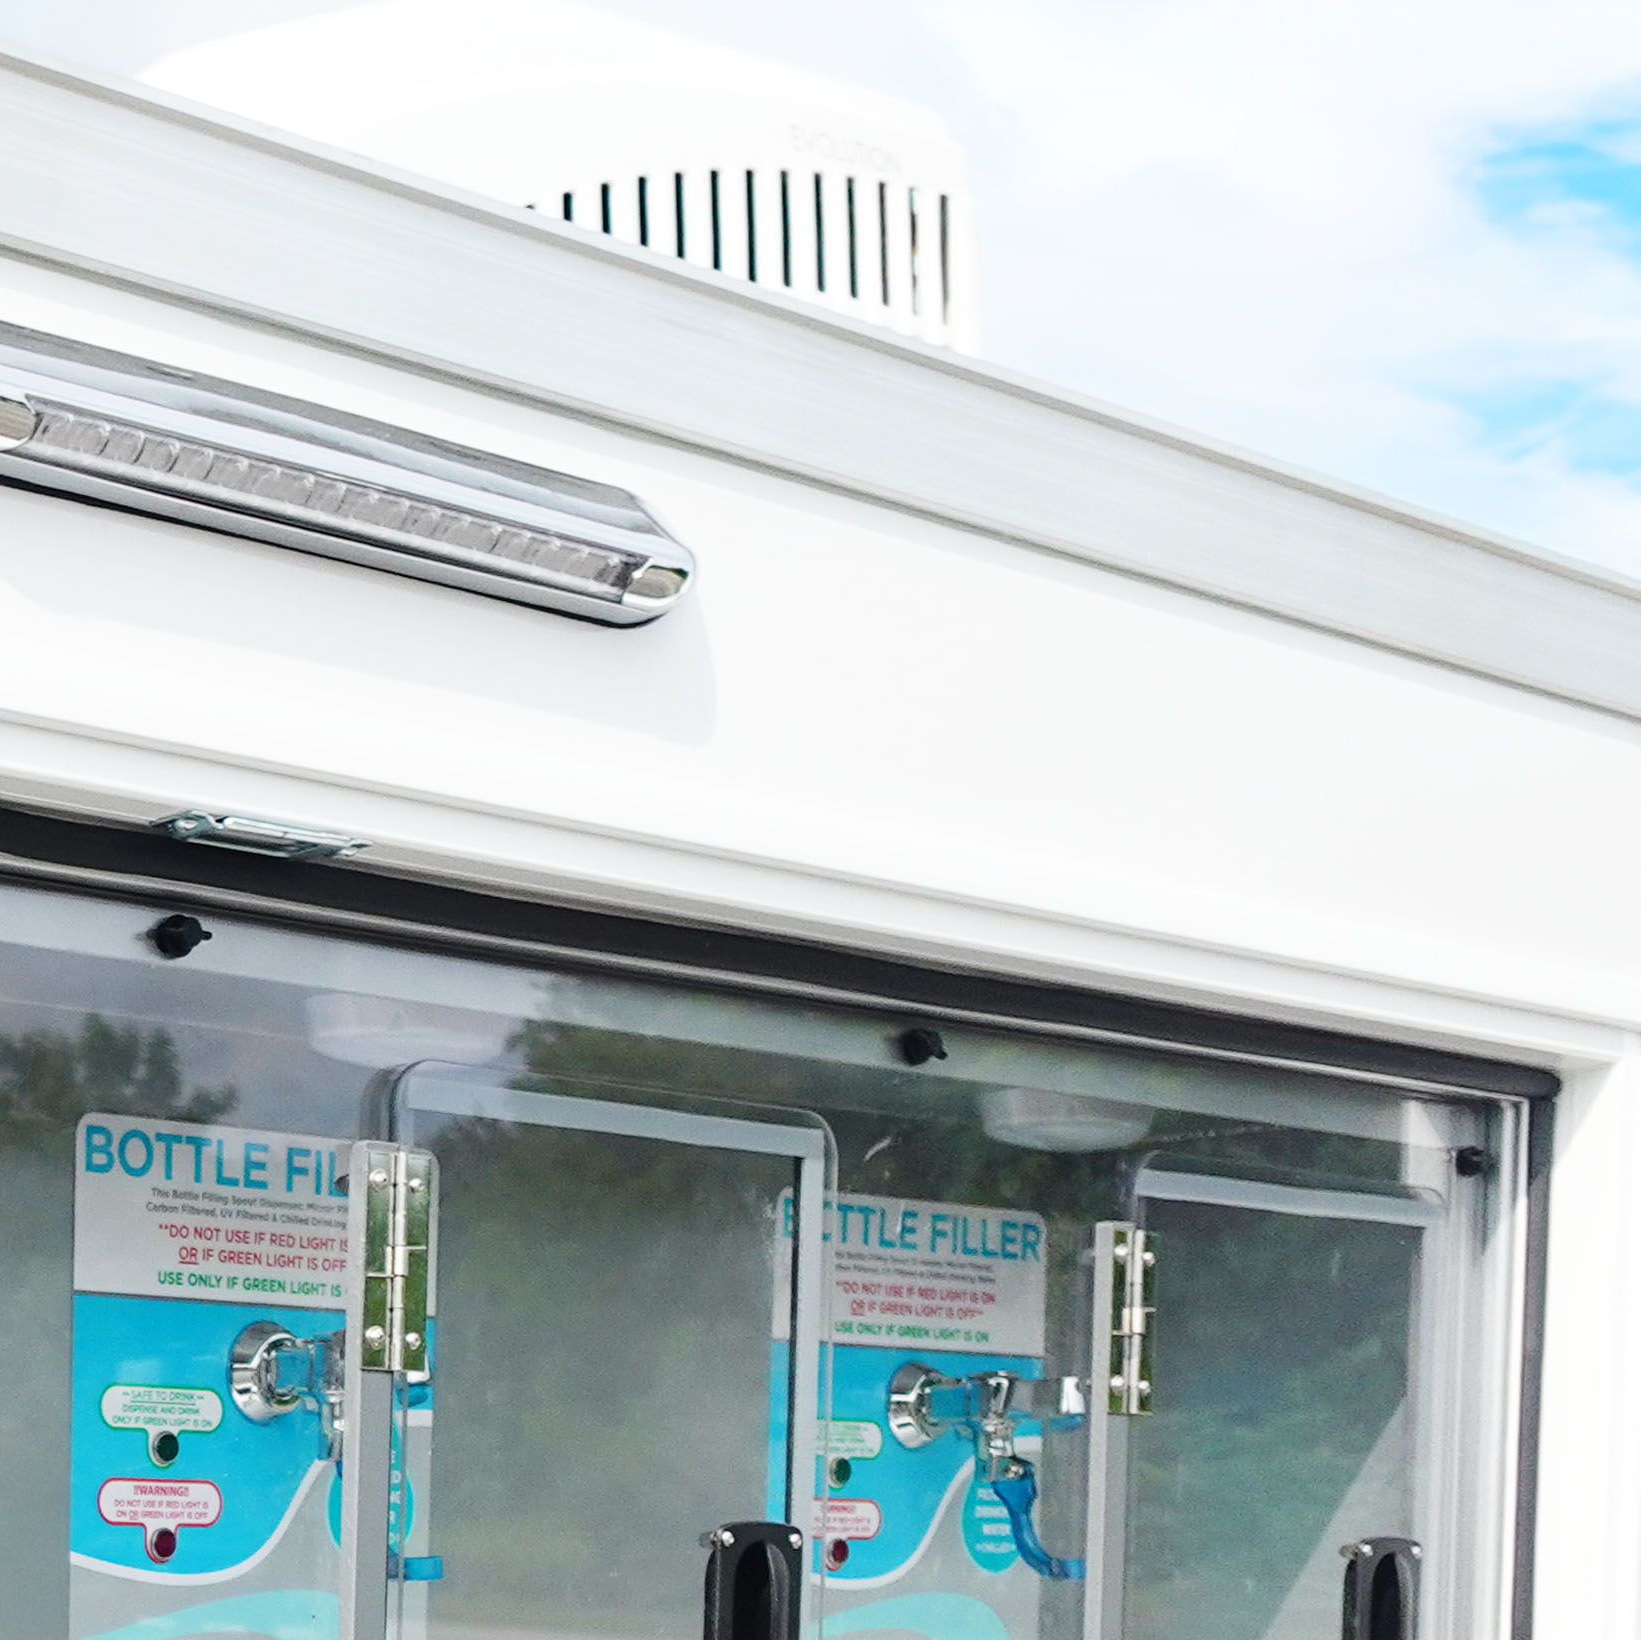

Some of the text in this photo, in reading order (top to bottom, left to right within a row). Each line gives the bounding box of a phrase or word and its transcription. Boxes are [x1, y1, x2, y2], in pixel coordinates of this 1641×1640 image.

[790, 125, 901, 173] EVOLUTION
[85, 1124, 268, 1189] BOTTLE
[194, 1226, 221, 1242] NOT
[225, 1229, 250, 1244] USE
[254, 1231, 265, 1245] IF
[270, 1232, 295, 1248] RED
[300, 1235, 336, 1251] LIGHT
[930, 1213, 1041, 1261] FILLER
[179, 1246, 198, 1264] OR
[203, 1248, 214, 1262] IF
[218, 1249, 261, 1265] GREEN
[267, 1253, 303, 1269] LIGHT
[307, 1256, 318, 1270] IS
[158, 1270, 341, 1297] USE ONLY IF GREEN LIGHT IS
